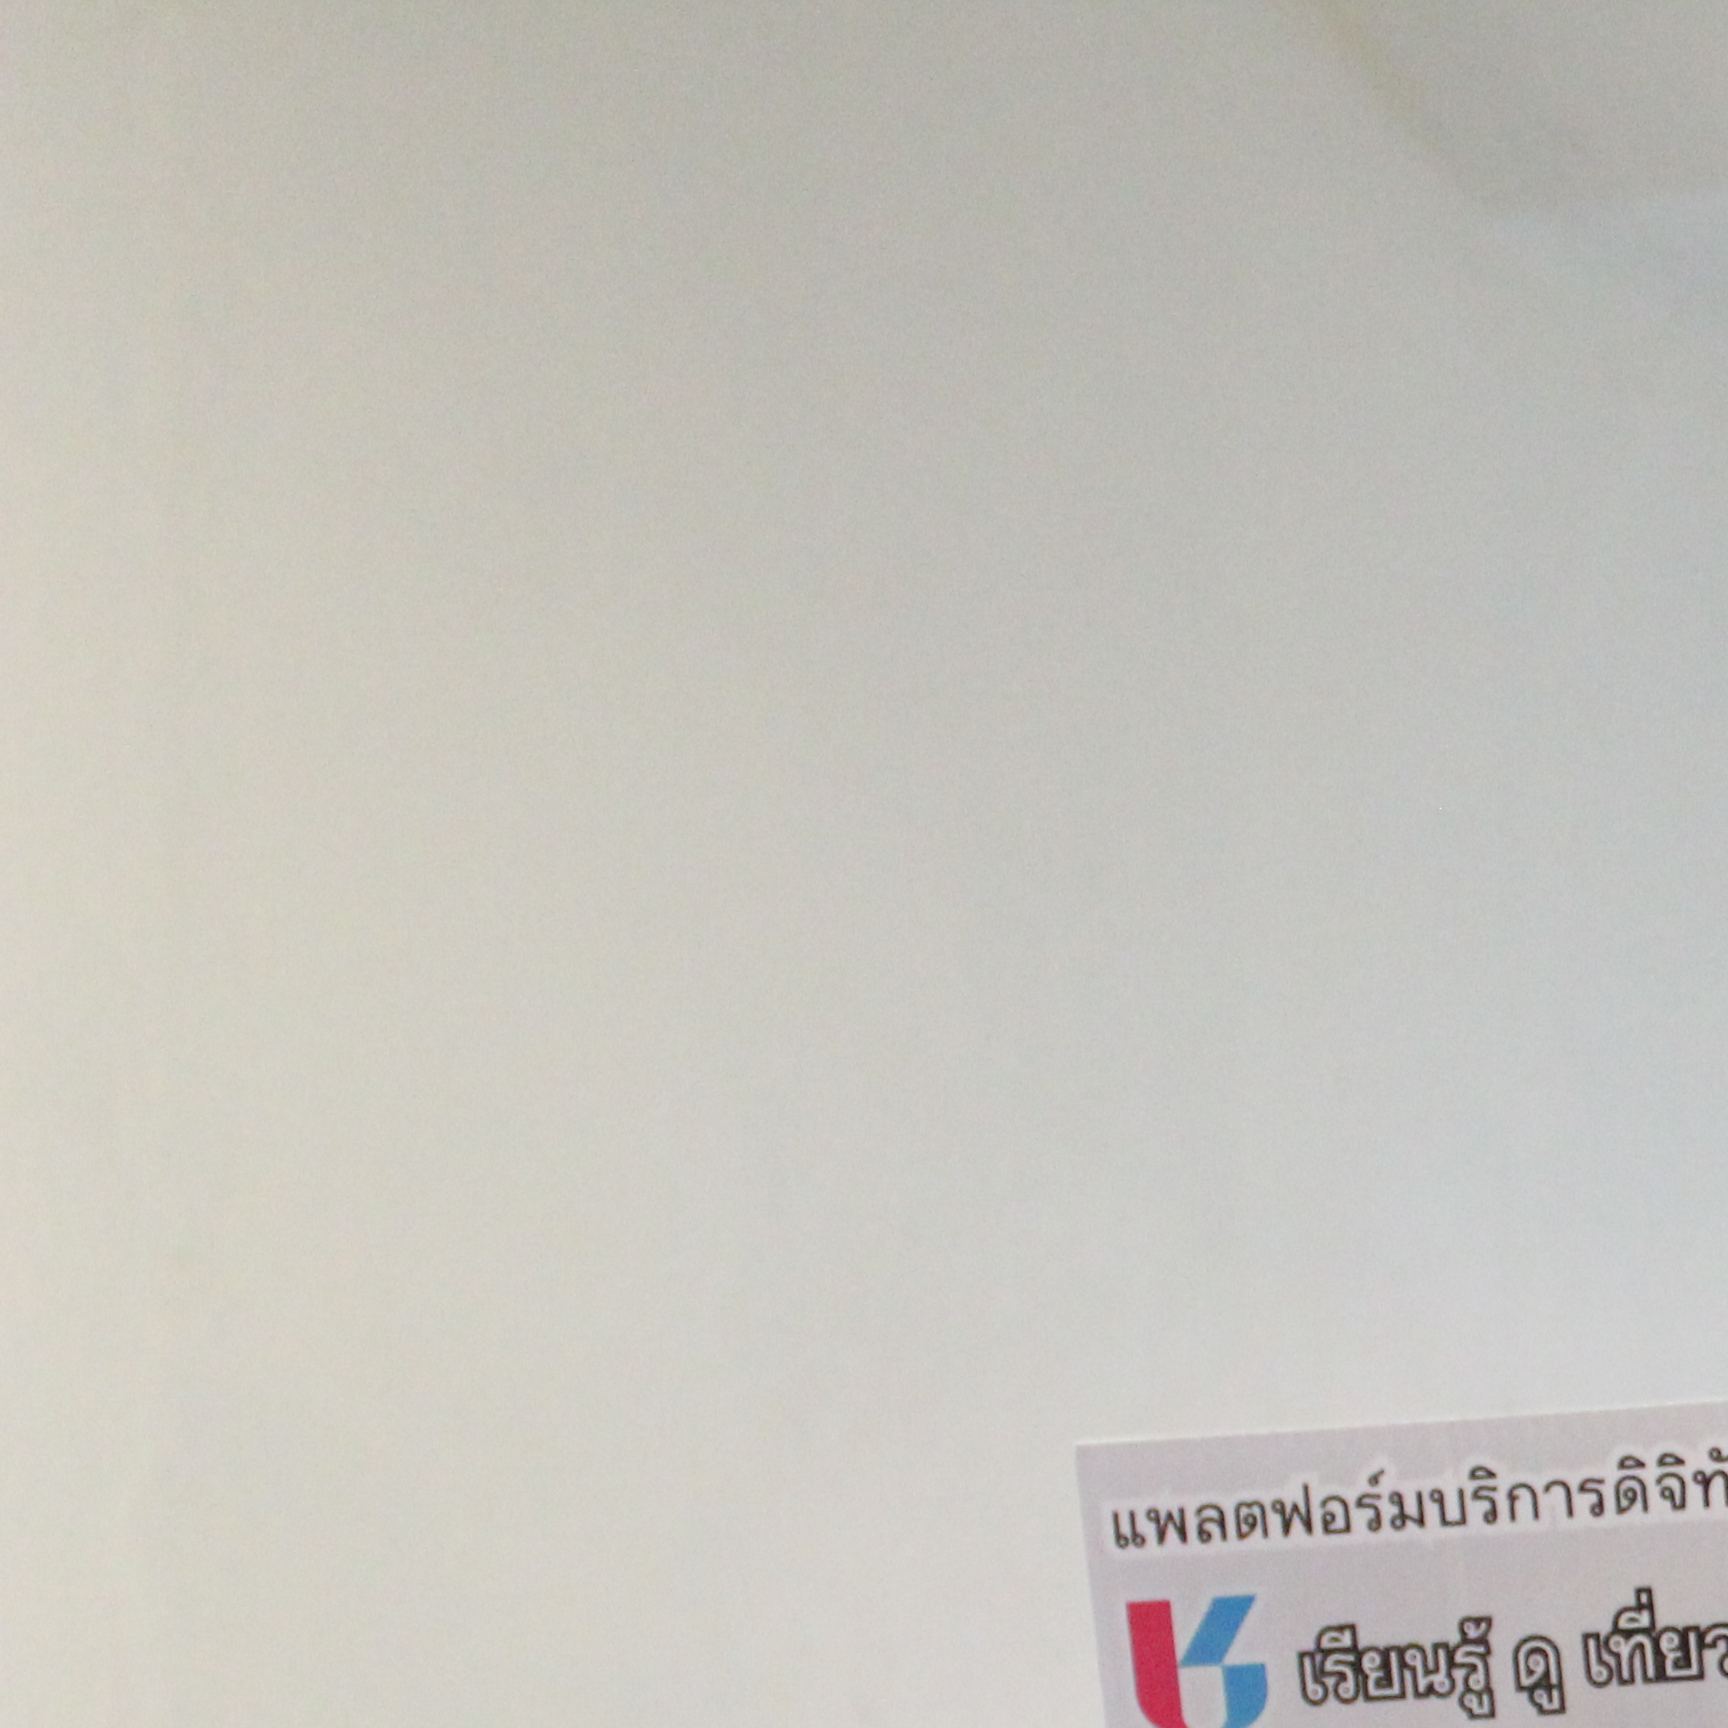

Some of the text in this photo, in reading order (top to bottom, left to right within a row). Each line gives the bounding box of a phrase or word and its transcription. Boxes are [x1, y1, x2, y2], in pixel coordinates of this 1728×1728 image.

[1298, 1616, 1496, 1720] เรียนรู้
[1512, 1635, 1566, 1716] ดู
